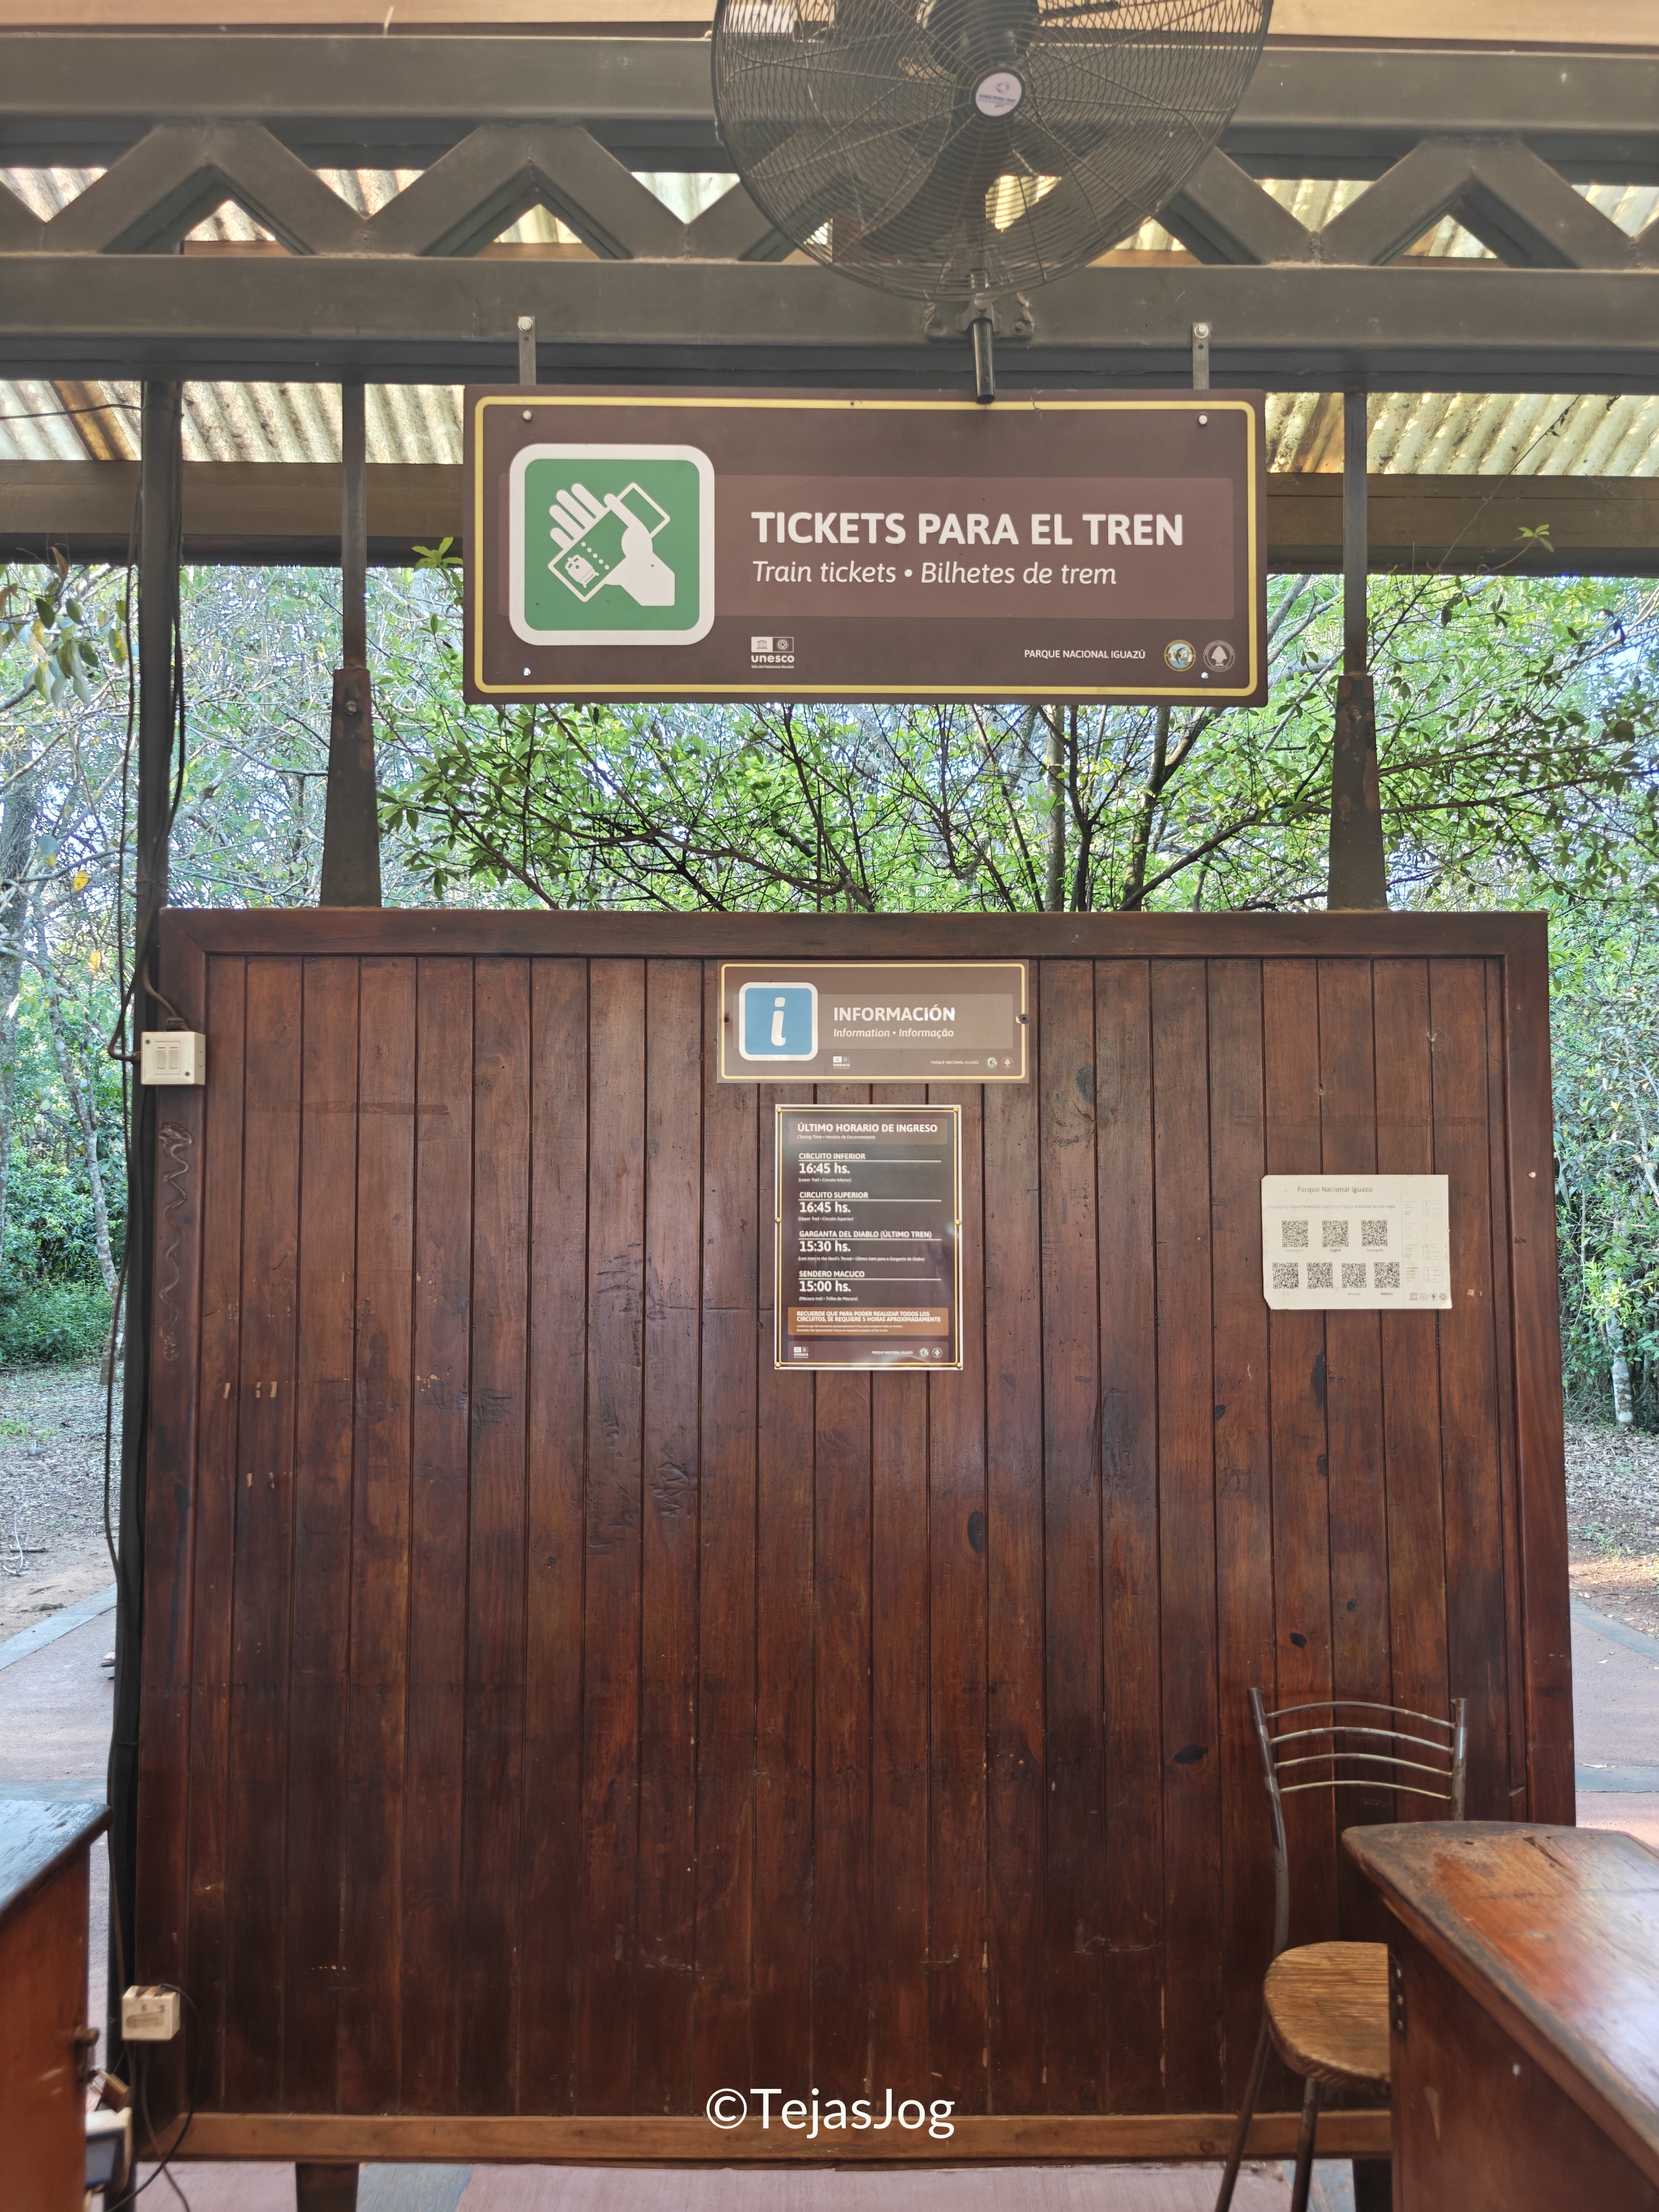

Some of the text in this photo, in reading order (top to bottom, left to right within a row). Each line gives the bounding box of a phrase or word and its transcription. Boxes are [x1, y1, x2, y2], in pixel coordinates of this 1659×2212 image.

[751, 511, 1184, 547] TICKETS PARA EL TREN
[752, 561, 1117, 585] Train tickets Bilhetes de trem
[1025, 649, 1146, 659] PARQUE NACIONAL IGUAZÚ
[834, 1004, 955, 1021] INFORMACIÓN
[833, 1028, 954, 1039] Information Informação
[798, 1122, 938, 1132] ÚLTIMO HORARIO DE INGRESO
[799, 1162, 850, 1174] 16:45 hs.
[1351, 1186, 1373, 1194] Iguazú
[800, 1201, 851, 1213] 16:45 hs.
[880, 1230, 909, 1239] (ÚLTIMO
[800, 1240, 851, 1252] 15:30 hs.
[800, 1280, 852, 1292] 15:00 hs.
